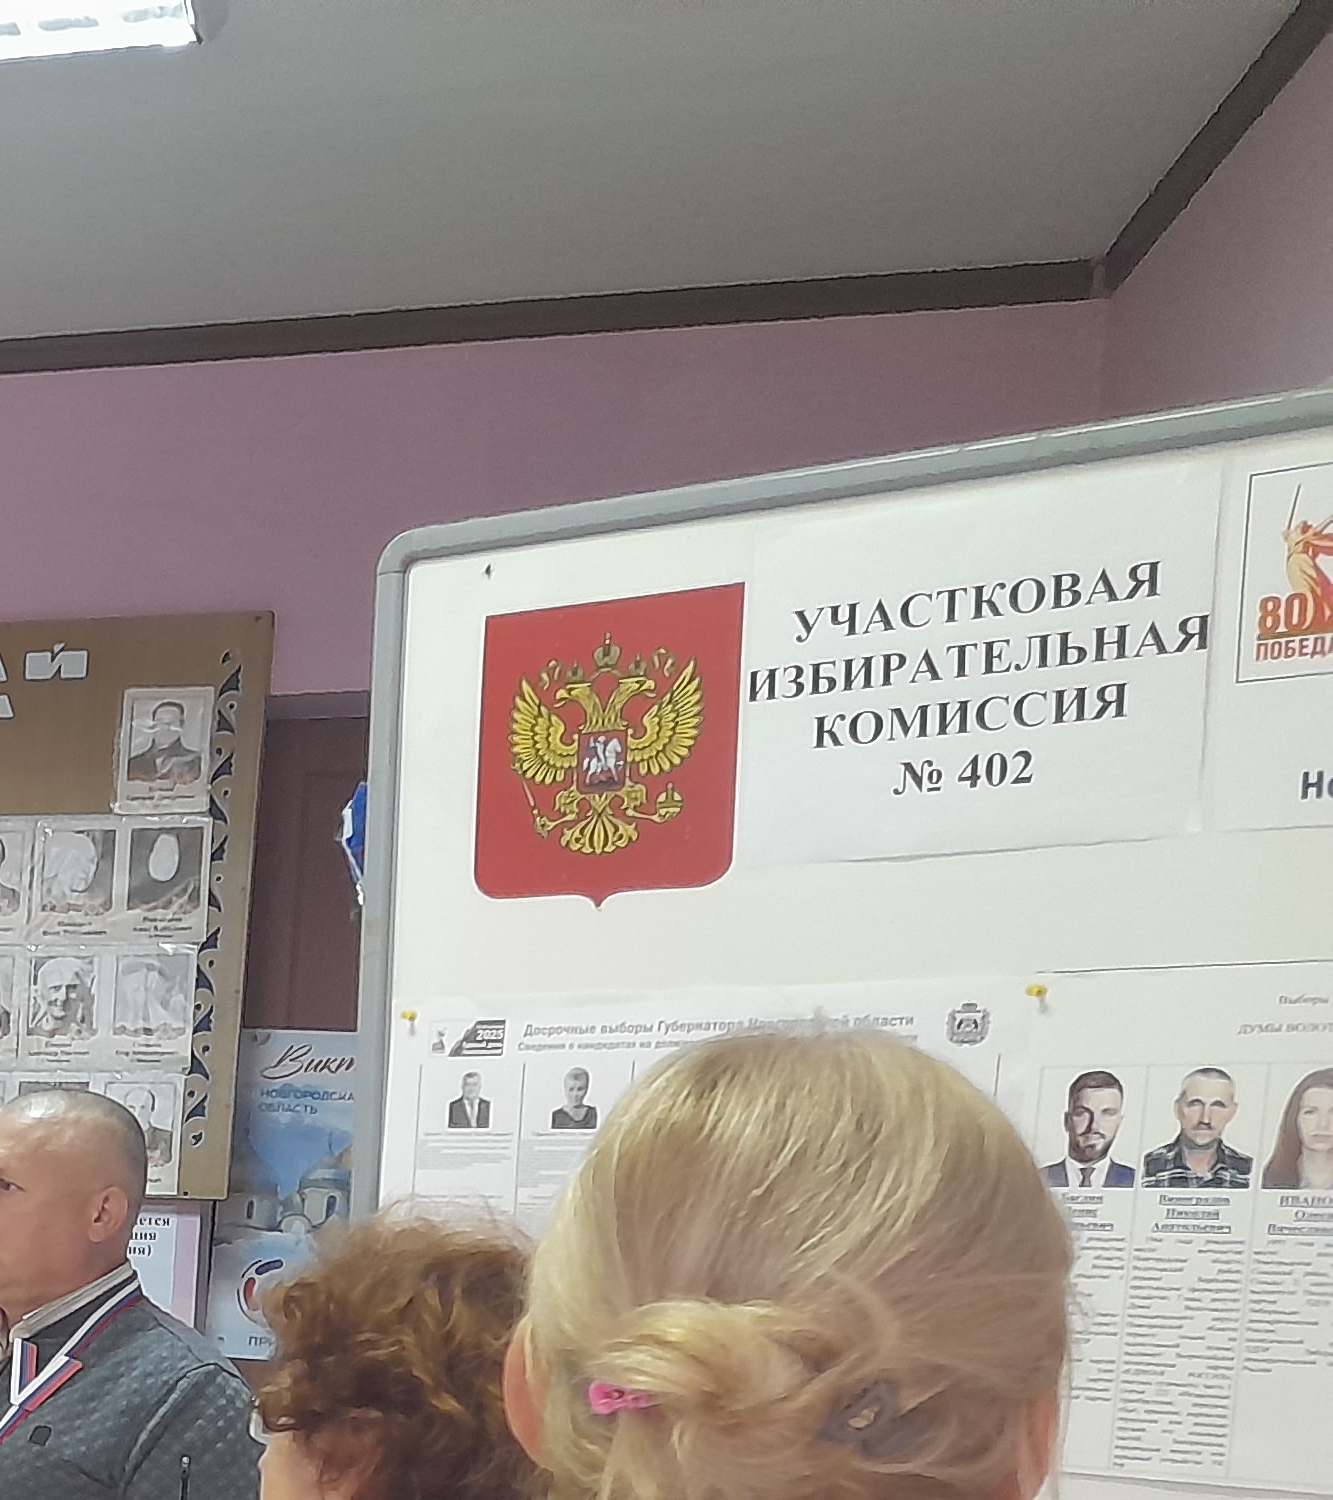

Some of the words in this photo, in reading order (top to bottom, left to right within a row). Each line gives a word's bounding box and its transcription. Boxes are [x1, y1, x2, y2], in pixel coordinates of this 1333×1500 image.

[793, 560, 1164, 645] УЧАСТКОВАЯ
[749, 614, 1212, 704] ИЗБИРАТЕЛЬНАЯ
[1255, 635, 1333, 662] ПОБЕД
[813, 682, 1129, 752] КОМИССИЯ
[892, 757, 943, 797] №
[957, 750, 1036, 792] 402
[600, 1021, 654, 1036] выборы
